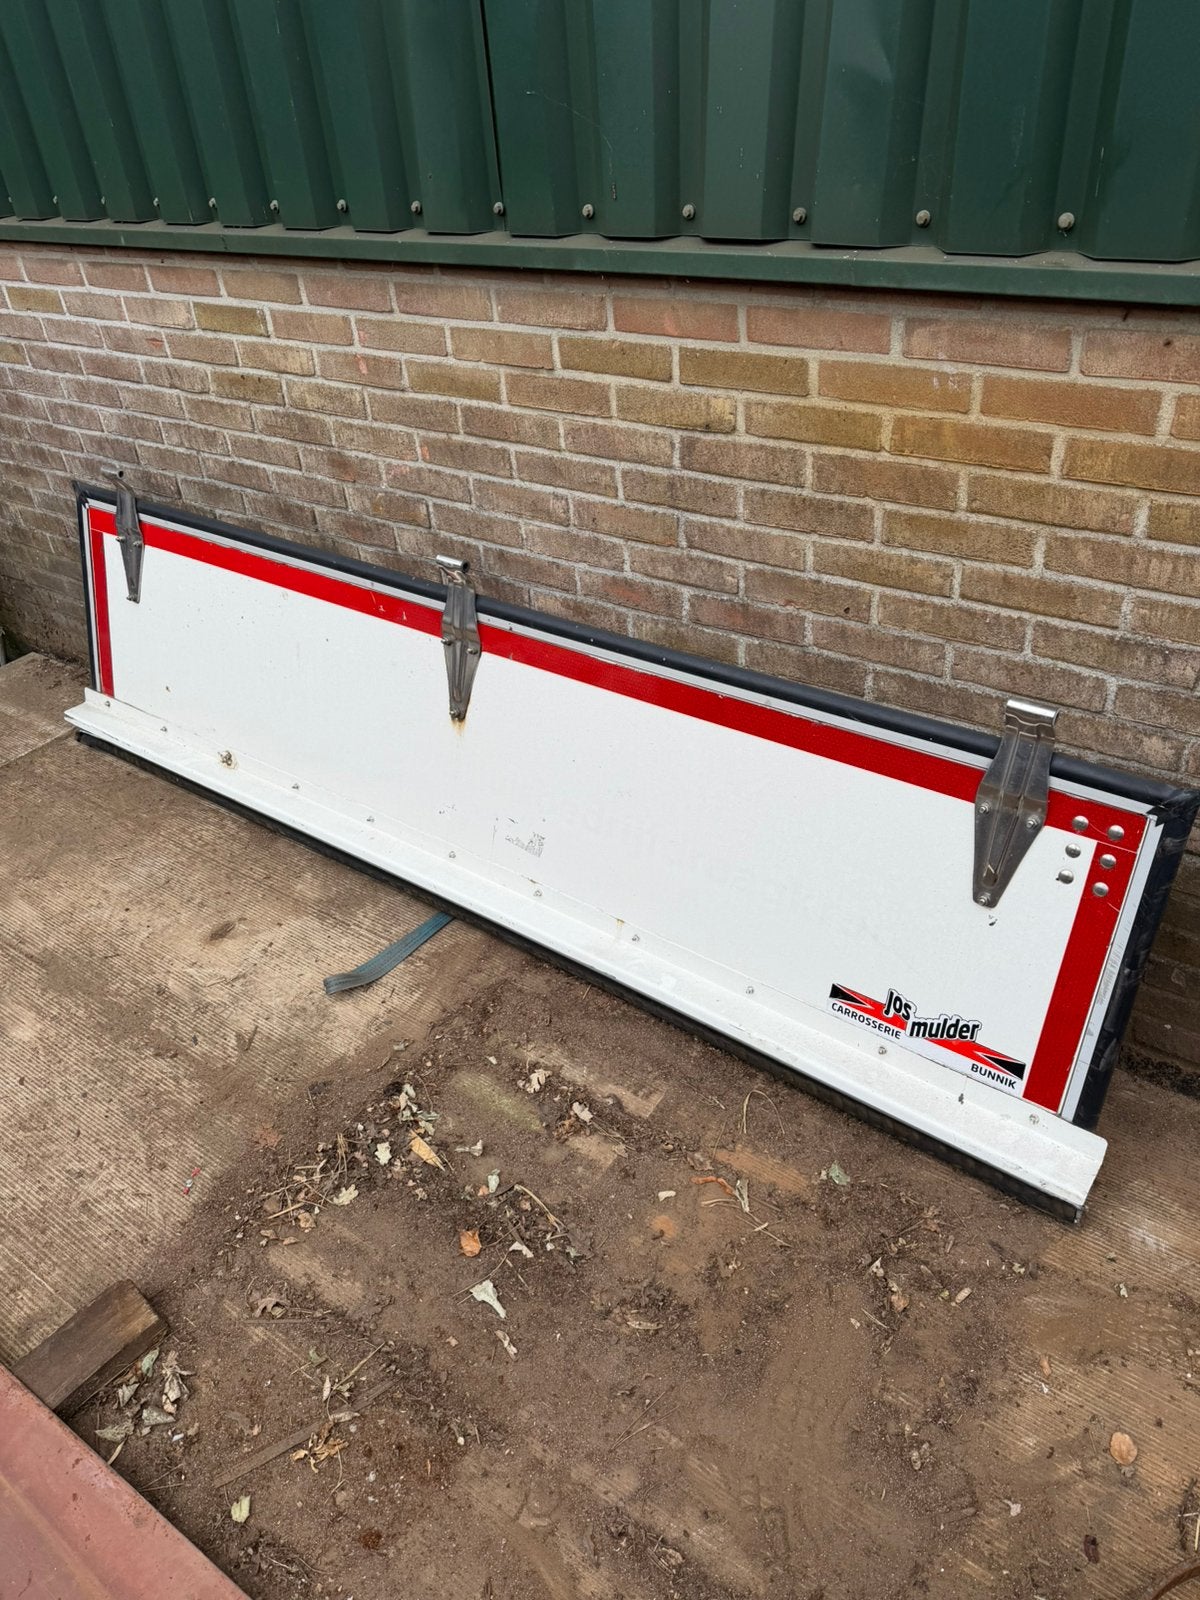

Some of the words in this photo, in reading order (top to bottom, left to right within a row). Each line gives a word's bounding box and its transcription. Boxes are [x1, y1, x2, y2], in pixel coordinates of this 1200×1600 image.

[831, 1002, 902, 1040] CARROSSERIE
[971, 1063, 1017, 1090] BUNNIK
[909, 1018, 980, 1040] mulder
